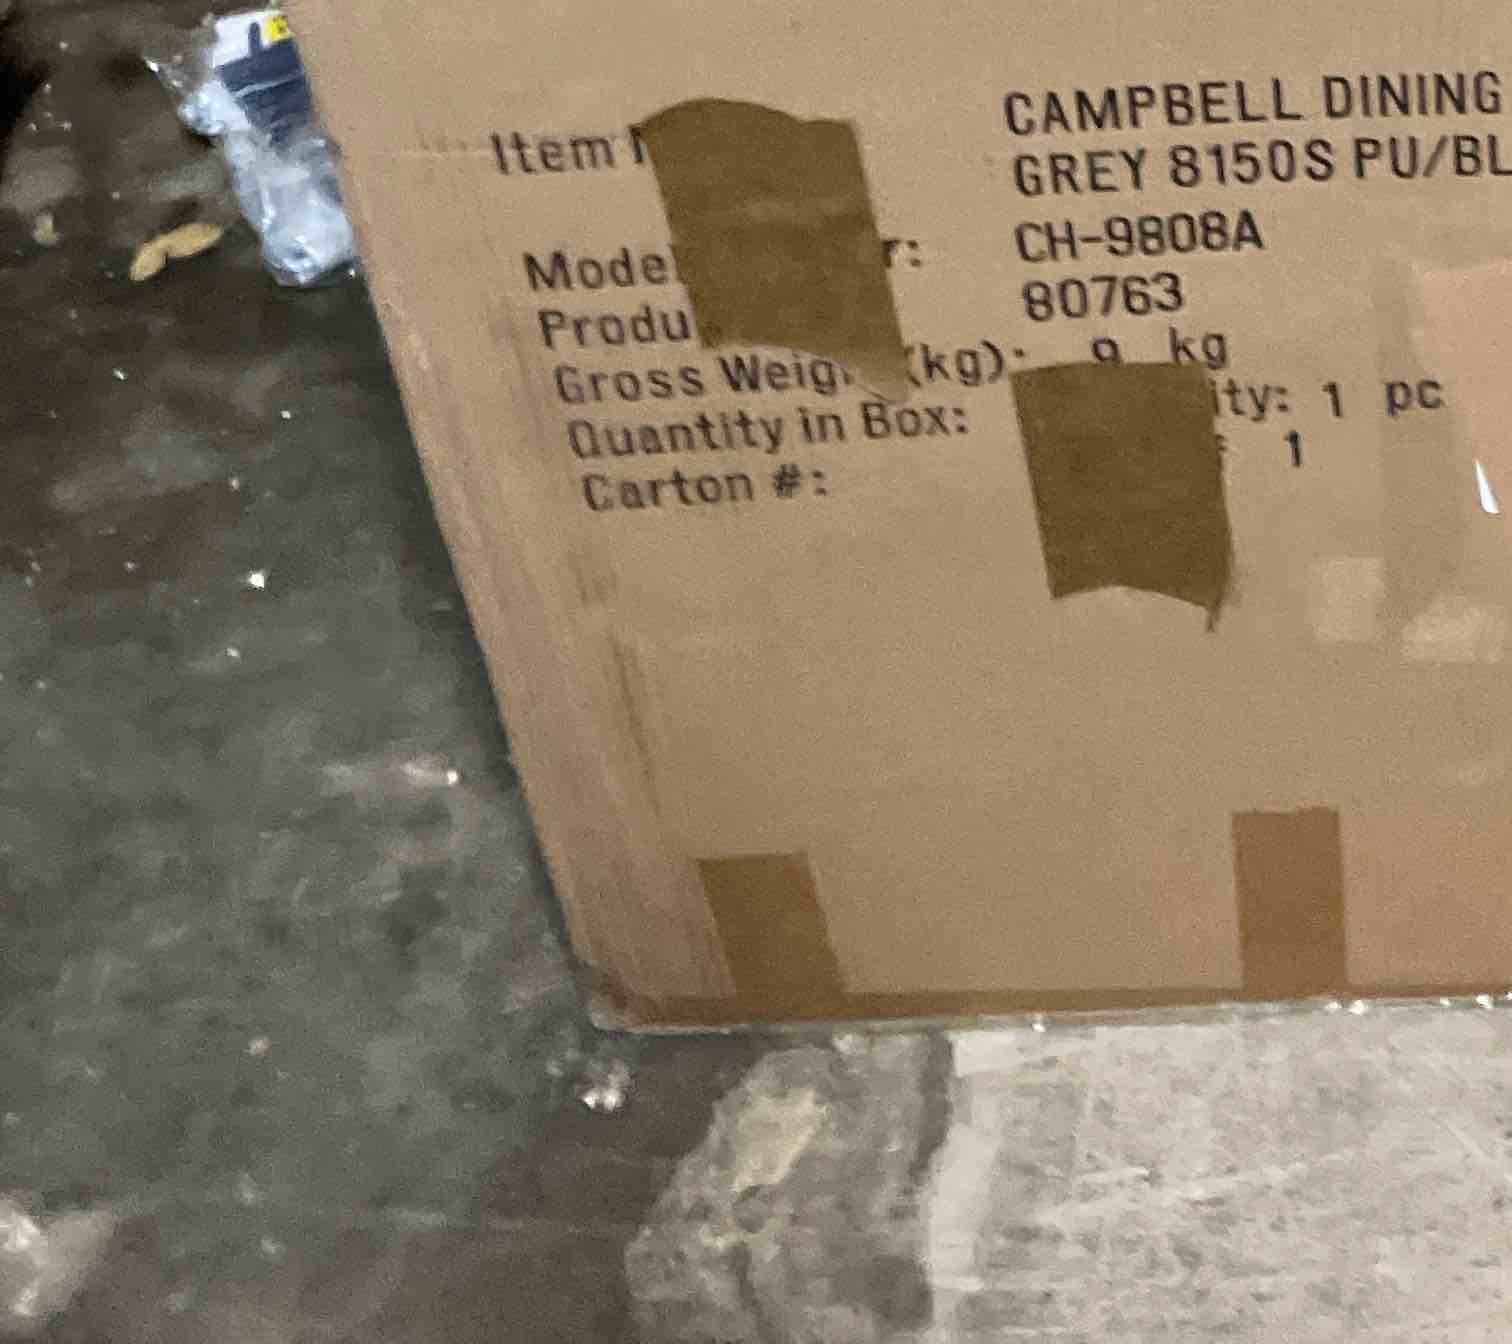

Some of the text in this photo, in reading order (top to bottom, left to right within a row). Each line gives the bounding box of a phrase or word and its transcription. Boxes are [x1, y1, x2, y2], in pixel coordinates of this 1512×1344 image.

[1004, 77, 1304, 137] CAMPBELL
[1322, 70, 1502, 118] DINING
[491, 130, 617, 175] Item
[1014, 148, 1148, 197] GREY
[1169, 139, 1336, 188] 8150S
[1014, 208, 1264, 263] CH-9808A
[523, 246, 672, 291] Mode
[1022, 271, 1185, 323] 80763
[554, 363, 704, 404] Gross
[718, 353, 854, 396] Weig
[1168, 325, 1228, 371] kg
[1321, 381, 1343, 418] 1
[1385, 378, 1444, 419] pc
[568, 401, 969, 460] Quantity in Box:
[1283, 429, 1303, 467] 1
[582, 468, 756, 512] Carton
